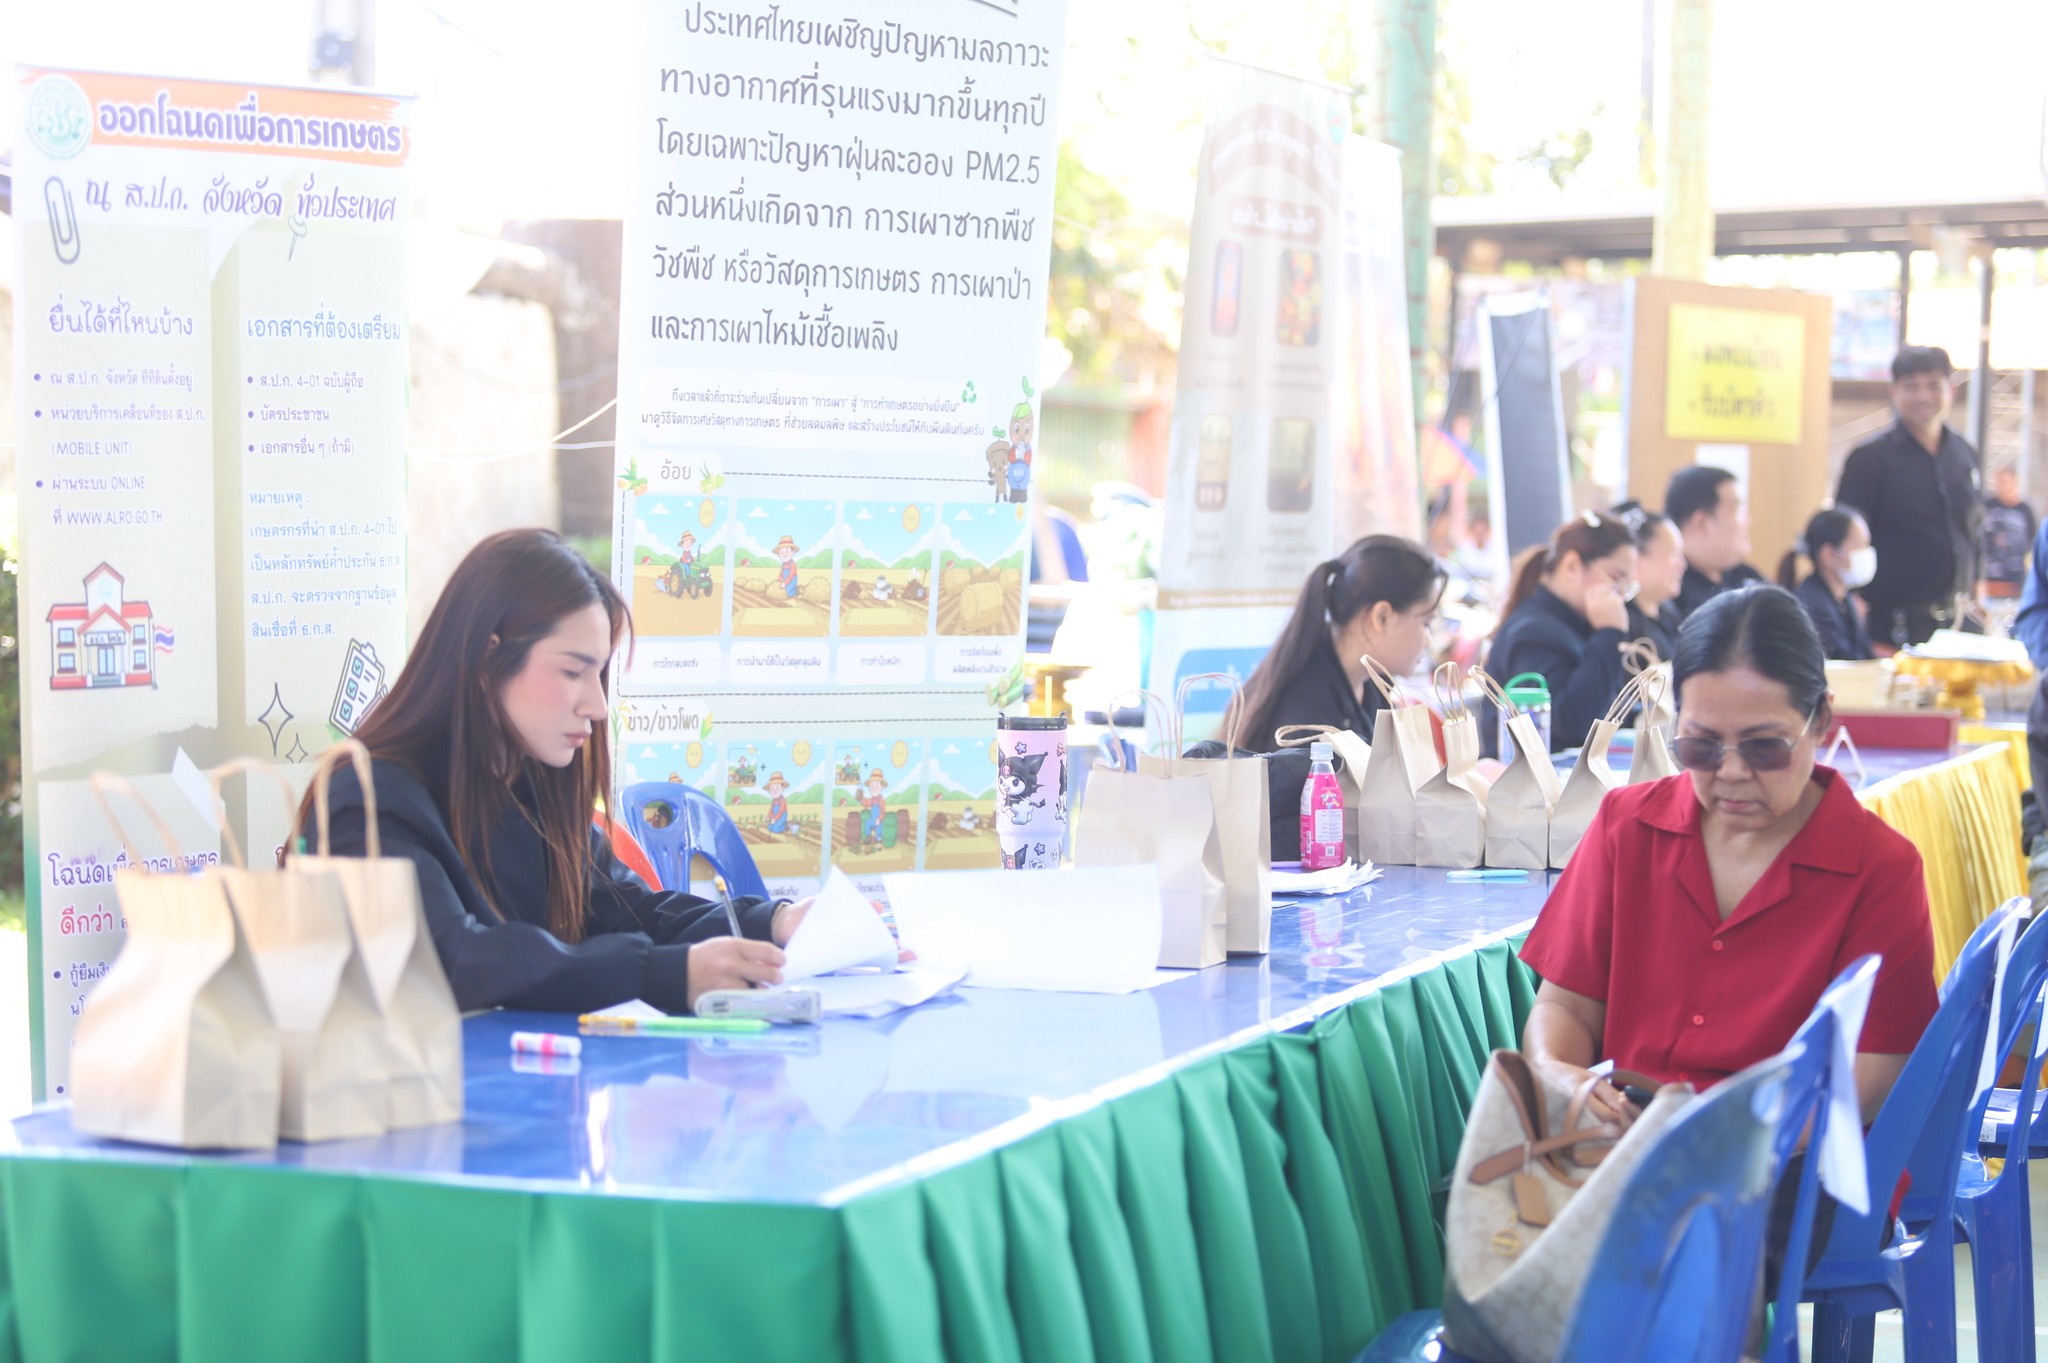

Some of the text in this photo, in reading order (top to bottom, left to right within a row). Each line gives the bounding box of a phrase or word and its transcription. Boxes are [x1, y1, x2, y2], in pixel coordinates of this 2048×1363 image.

[684, 2, 1049, 68] ประเทศไทยเผชิญปัญหามลภาวะ
[660, 61, 1046, 134] ทางอากาศที่รุนแรงมากขึ้นทุกปี
[100, 93, 401, 152] ออกโฉนดเพื่อการเกษตร
[657, 118, 1040, 184] โดยเฉพาะปัญหาฝุ่นละออง PM2.5
[86, 172, 397, 222] ณ ส.ป.ก. จังหวัด ทั่วประเทศ
[656, 176, 1035, 242] ส่วนหนึ่งเกิดจาก การเผาซากพืช
[653, 245, 1031, 301] วัชพืช หรือวัสดุการเกษตร การเผาป่า
[50, 294, 193, 335] ยื่นได้ที่ไหนบ้าง
[248, 301, 400, 340] เอกสารที่ต้องเตรียม
[651, 303, 898, 351] และการเผาไหม้เชื้อเพลิง
[67, 371, 102, 385] ส.ป.ก.
[260, 371, 364, 394] ส.ป.ก. 4-01 ฉบับผู้ถือ
[50, 398, 173, 421] หน่วยบริการเคลื่อนที่ของ
[261, 404, 329, 421] บัตรประชาชน
[51, 441, 133, 456] (MOBILE UNIT)
[261, 433, 315, 454] เอกสารอื่น
[660, 459, 692, 480] อ้อย
[52, 474, 146, 490] ผ่านระบบ ONLINE
[250, 491, 303, 509] หมายเหตุ
[53, 504, 163, 525] ที่ WWW.ALRO.GO.TH
[250, 516, 325, 537] เกษตรกรที่นำ
[364, 522, 385, 535] 4-01
[251, 546, 376, 571] เป็นหลักทรัพย์ค้ำประกัน
[251, 591, 286, 604] ส.ป.ก.
[251, 616, 335, 638] สินเชื่อที่ ธ.ก.ส.
[628, 704, 699, 734] ข้าว/ข้าวโพด
[60, 904, 113, 934] ดีกว่า
